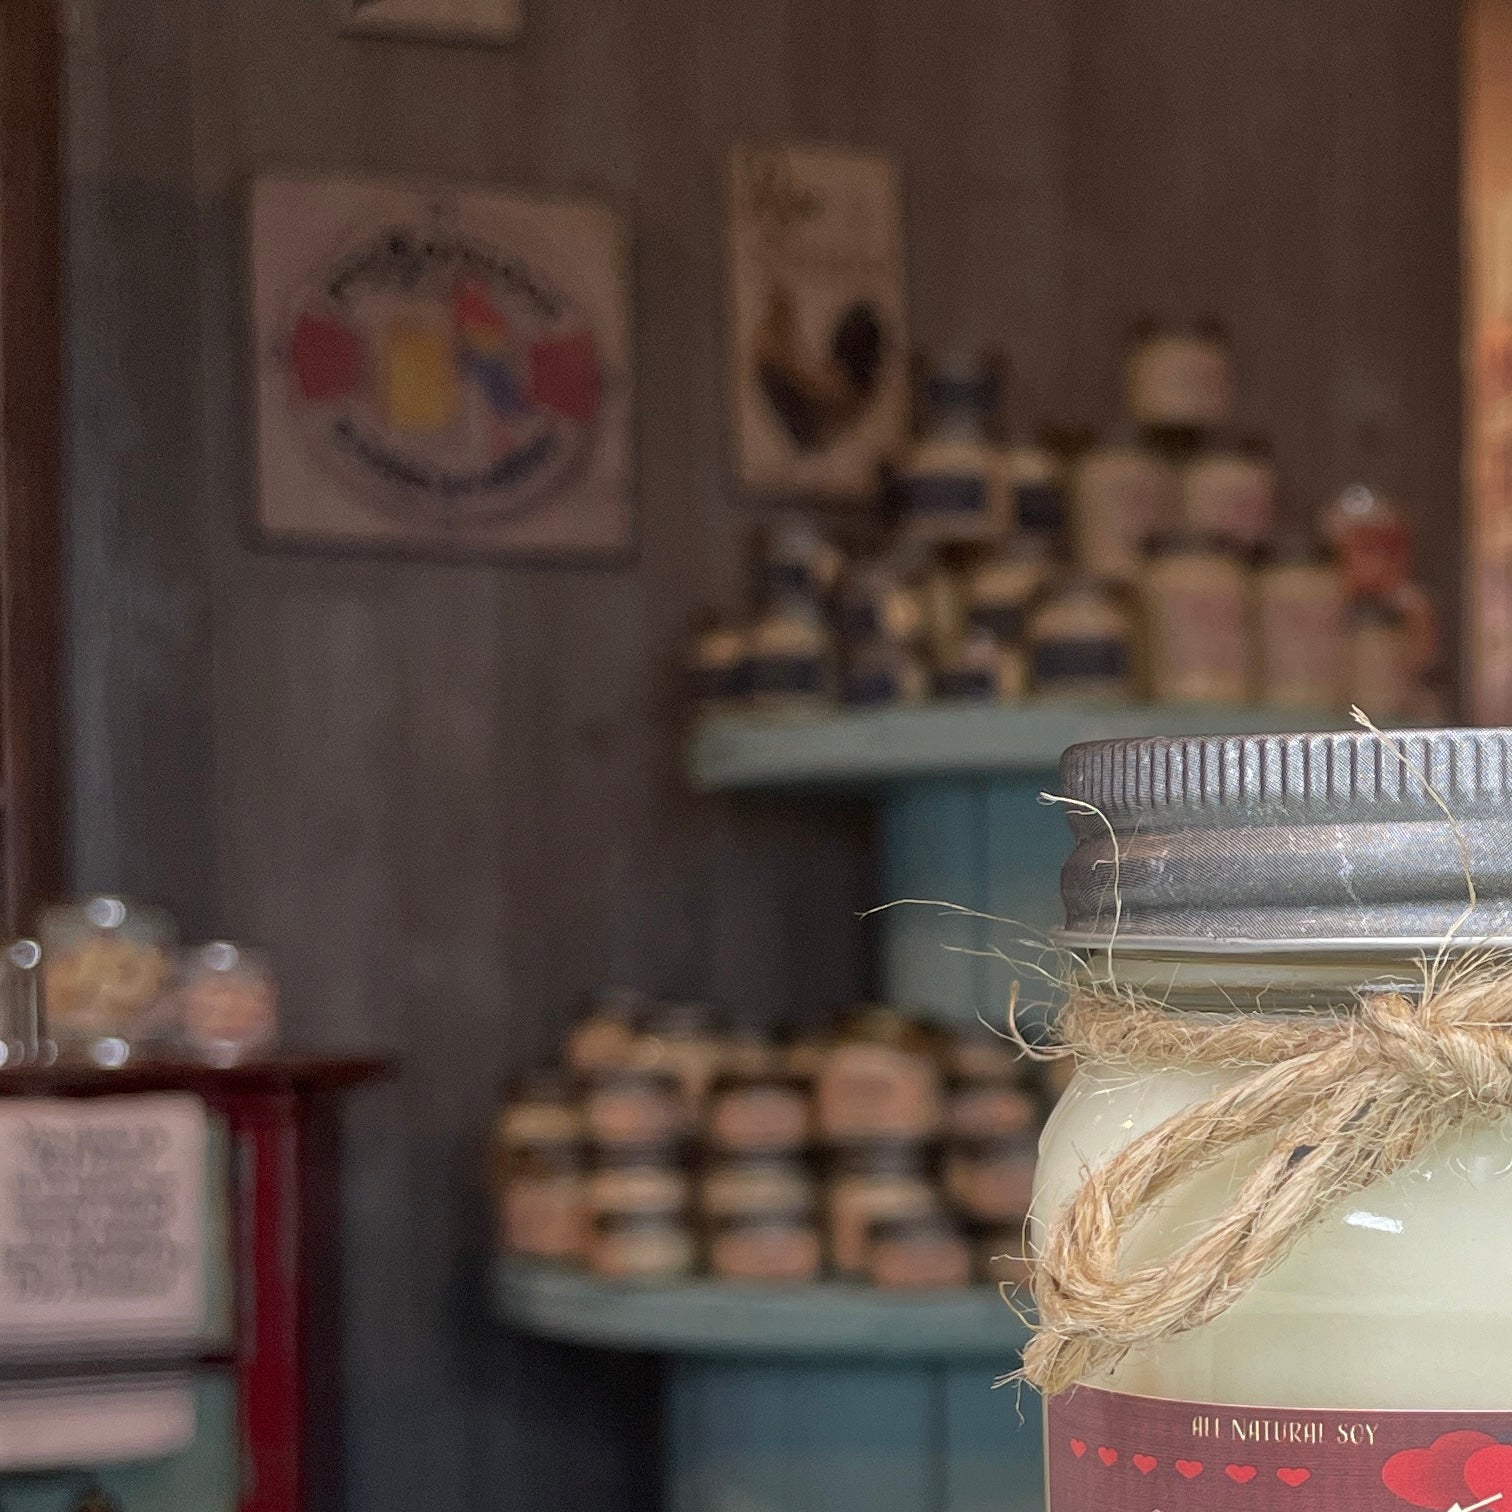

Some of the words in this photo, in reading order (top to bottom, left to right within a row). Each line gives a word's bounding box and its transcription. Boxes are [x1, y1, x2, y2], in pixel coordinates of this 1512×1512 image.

[1191, 1415, 1222, 1440] ALL
[1231, 1417, 1326, 1445] NATURAL
[1336, 1422, 1380, 1446] SOY
